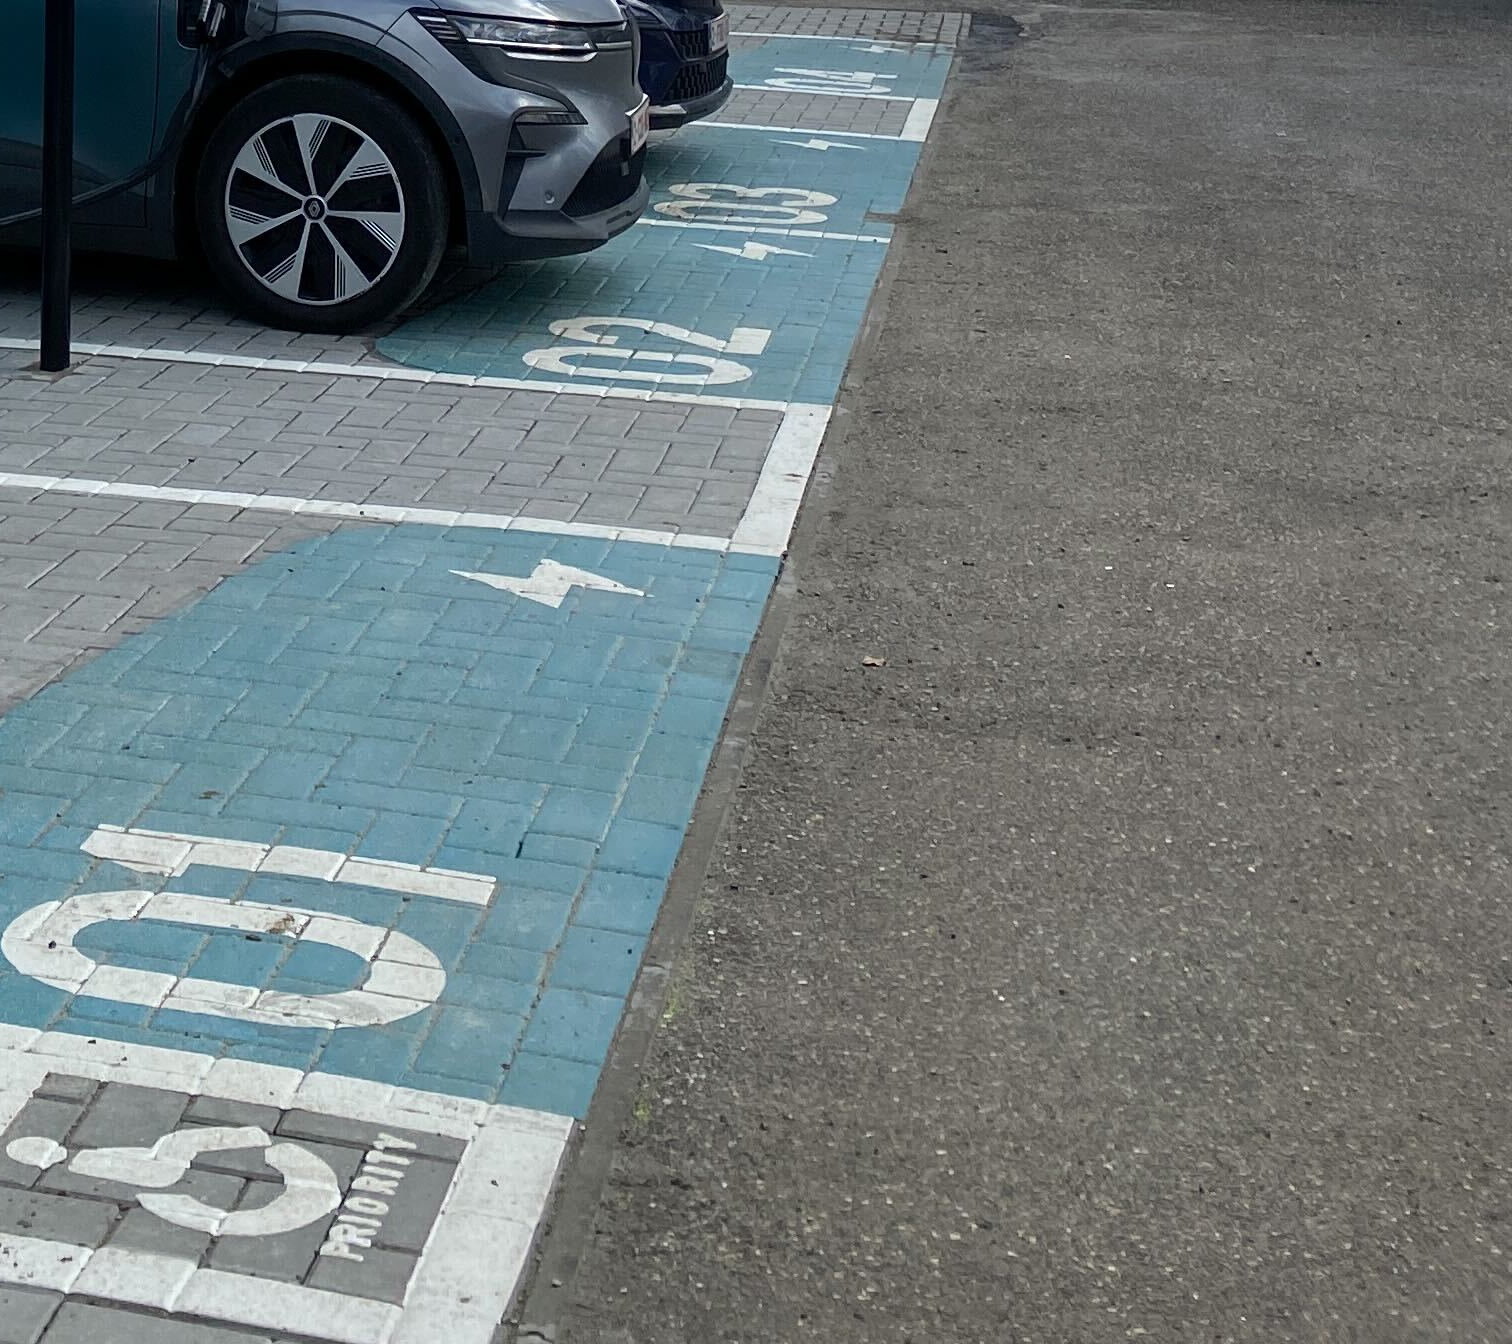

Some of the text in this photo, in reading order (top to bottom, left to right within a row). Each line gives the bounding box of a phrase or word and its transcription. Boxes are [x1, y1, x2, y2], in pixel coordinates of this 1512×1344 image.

[764, 67, 898, 94] 04
[654, 181, 839, 226] 03
[522, 316, 772, 387] 02
[0, 823, 497, 1030] 01
[319, 1132, 417, 1263] PRIORITY
